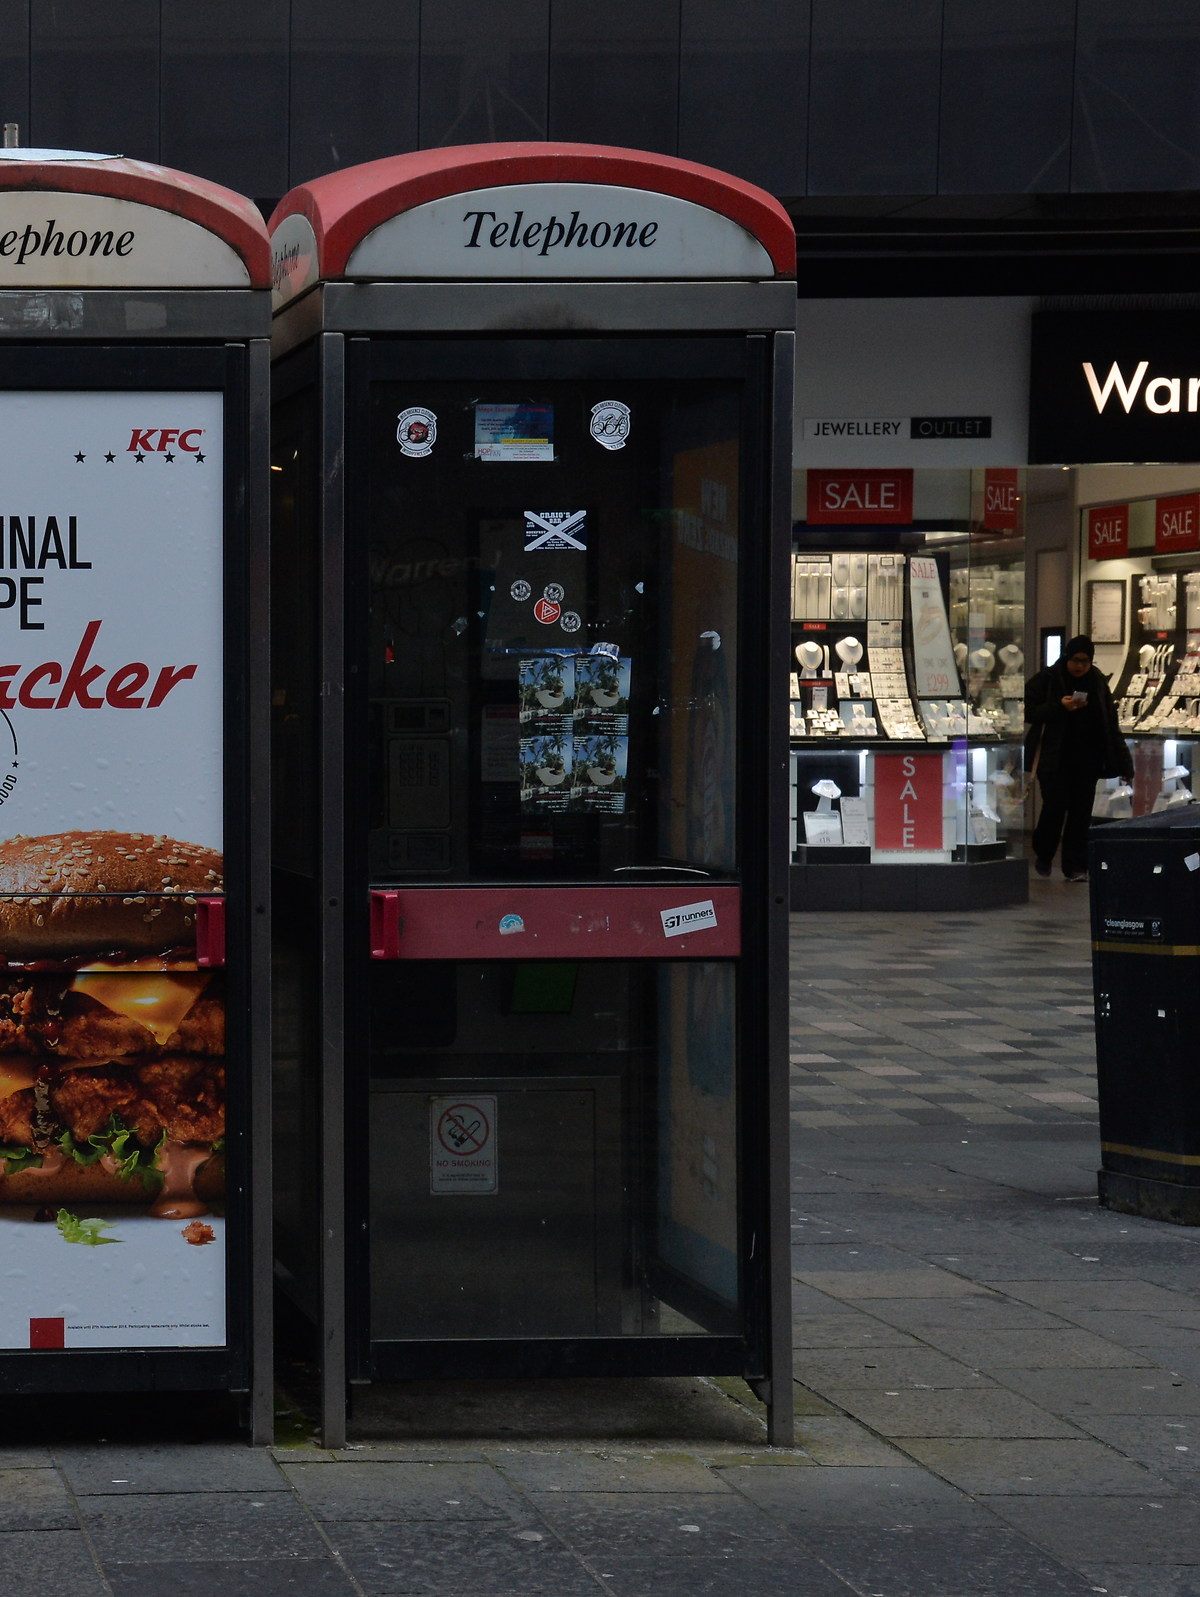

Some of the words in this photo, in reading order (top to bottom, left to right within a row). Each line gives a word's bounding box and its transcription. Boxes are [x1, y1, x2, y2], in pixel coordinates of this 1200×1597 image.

[463, 211, 658, 257] Telephone
[1082, 360, 1200, 415] War
[126, 428, 203, 452] KFC
[813, 421, 902, 436] JEWELLERY
[919, 420, 983, 436] OUTLET
[825, 482, 895, 509] SALE
[987, 485, 1015, 512] SALE
[1094, 519, 1122, 546] SALE
[1162, 510, 1193, 537] SALE
[910, 561, 936, 580] SALE
[900, 756, 918, 848] SALE
[664, 915, 681, 929] G1
[682, 909, 713, 921] runners
[451, 1160, 490, 1168] SMOKING
